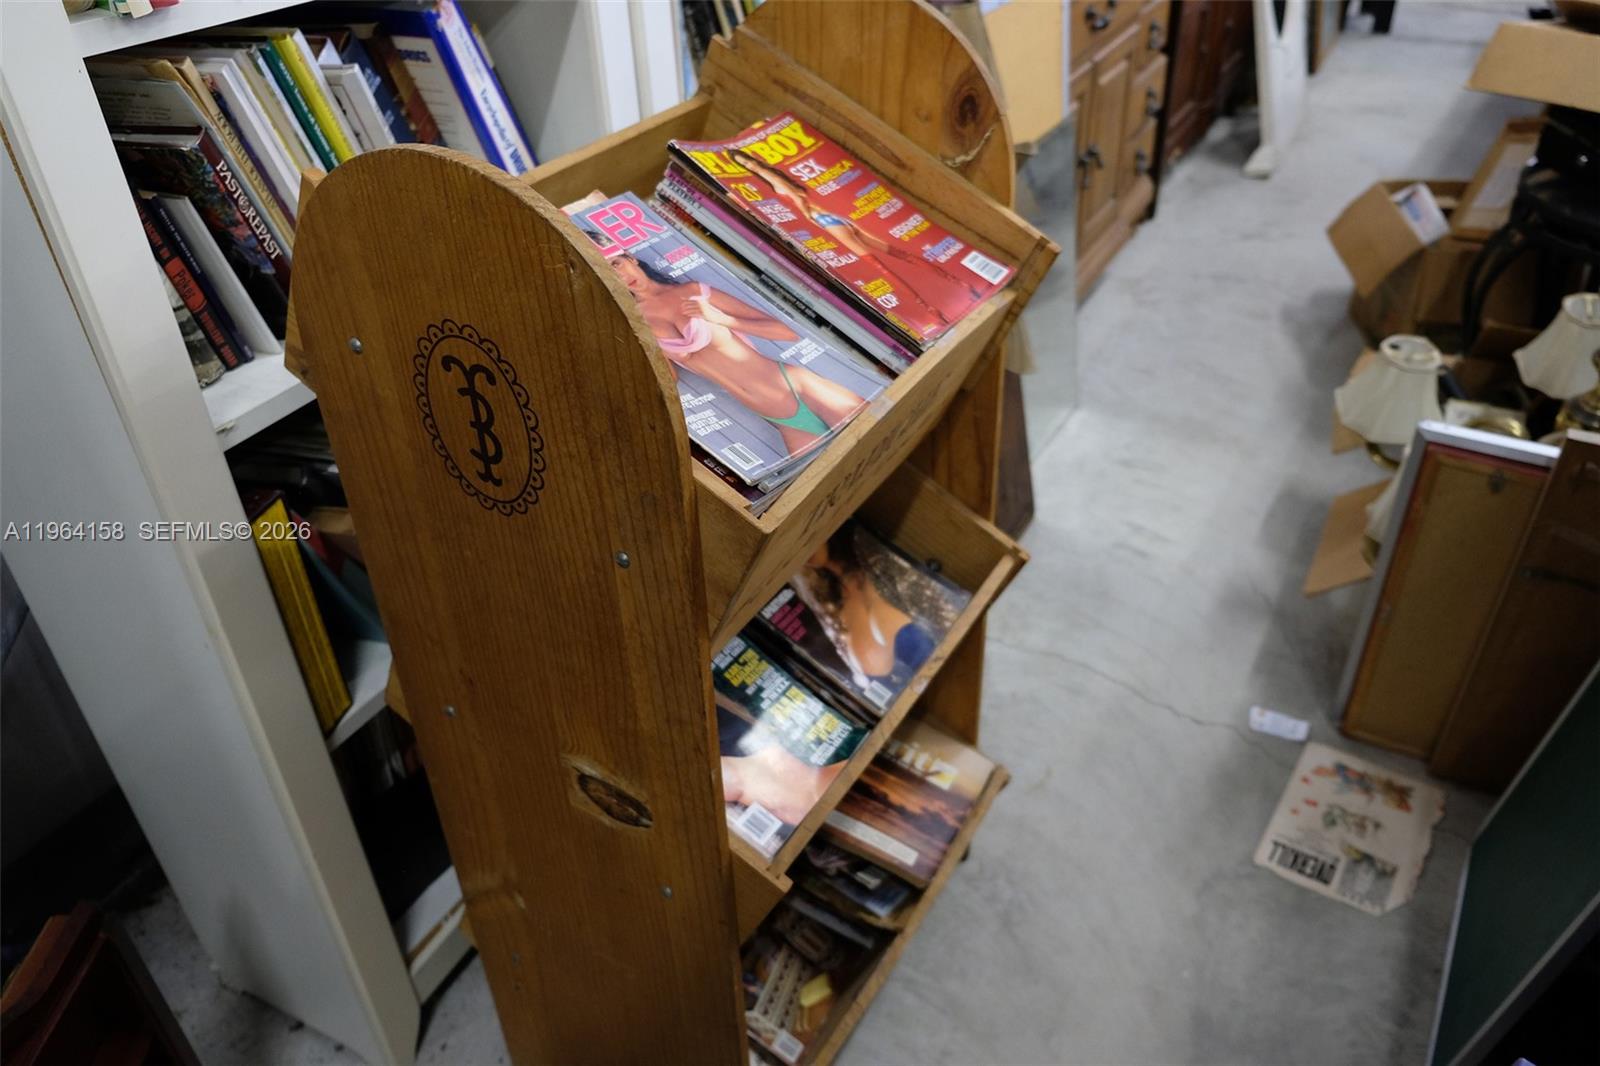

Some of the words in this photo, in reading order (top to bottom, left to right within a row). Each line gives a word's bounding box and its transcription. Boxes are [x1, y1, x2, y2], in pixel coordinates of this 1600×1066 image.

[789, 158, 828, 182] SEX
[216, 159, 244, 198] PAST
[245, 207, 284, 260] REPAST
[174, 269, 197, 299] Poker
